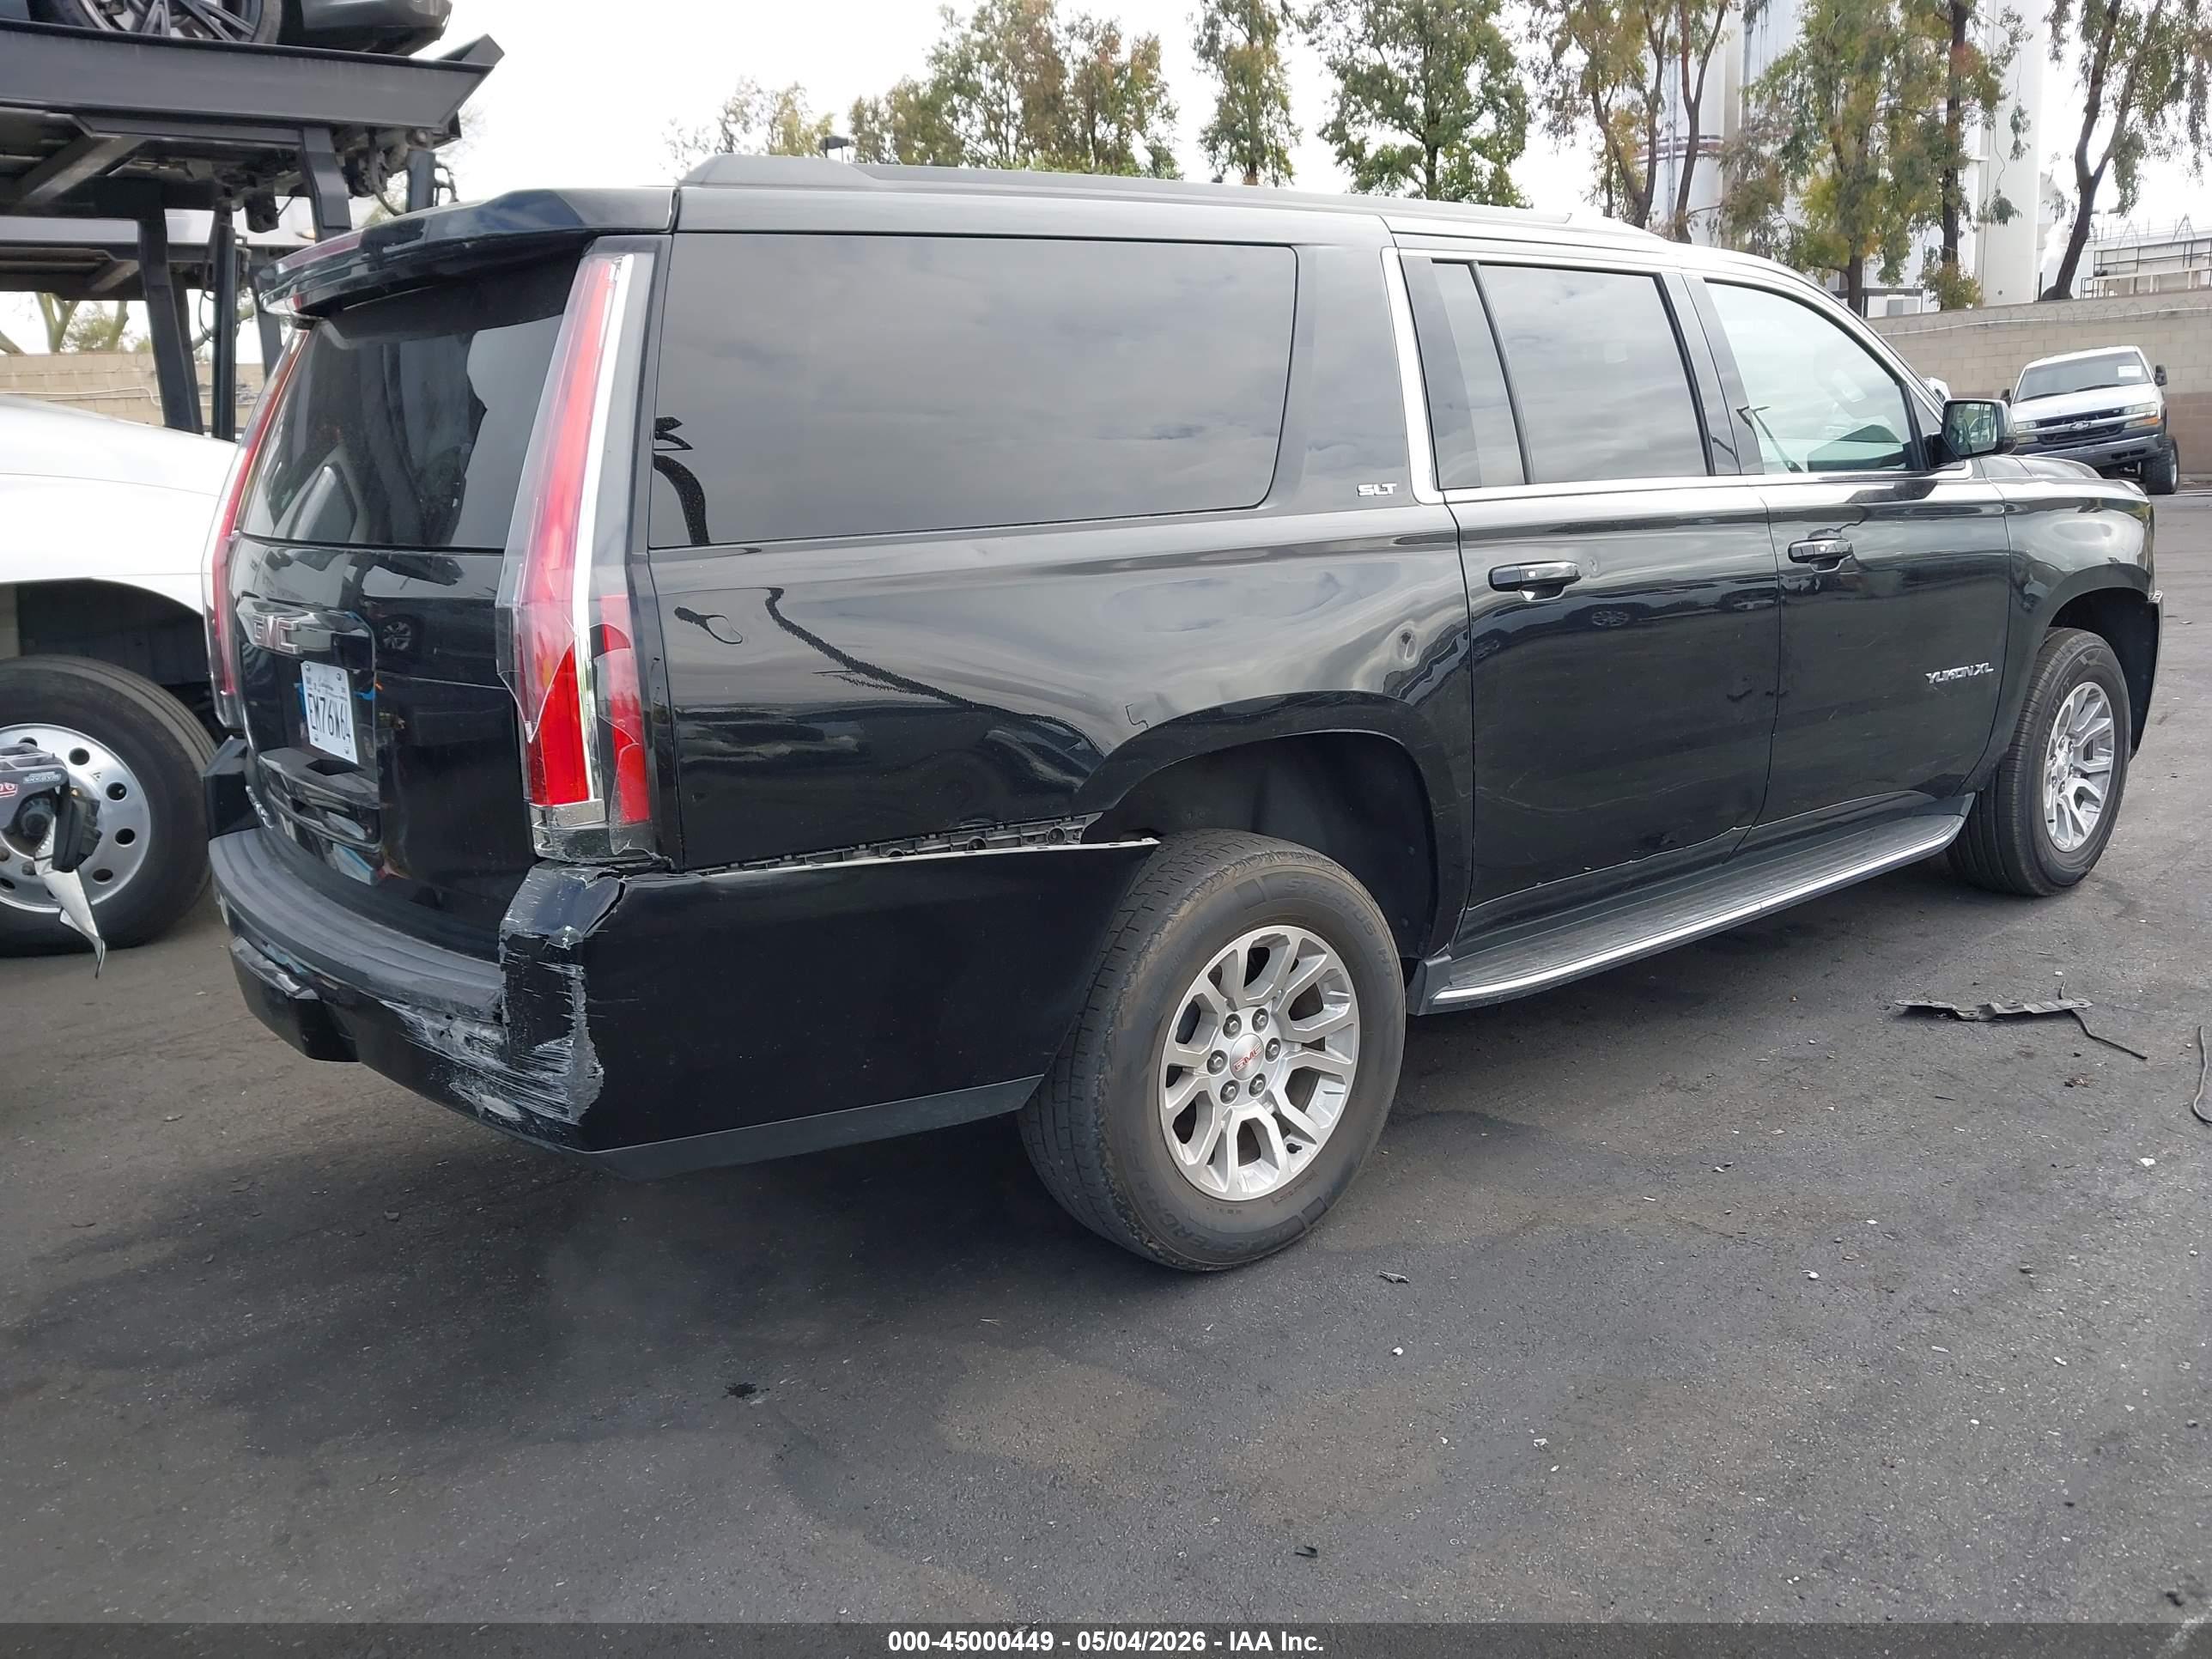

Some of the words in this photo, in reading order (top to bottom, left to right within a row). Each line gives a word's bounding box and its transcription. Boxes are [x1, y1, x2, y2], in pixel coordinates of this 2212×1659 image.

[1357, 483, 1397, 497] SLT
[252, 613, 301, 654] GMC
[1284, 875, 1377, 937] STRATUS
[1233, 1042, 1263, 1072] GMC
